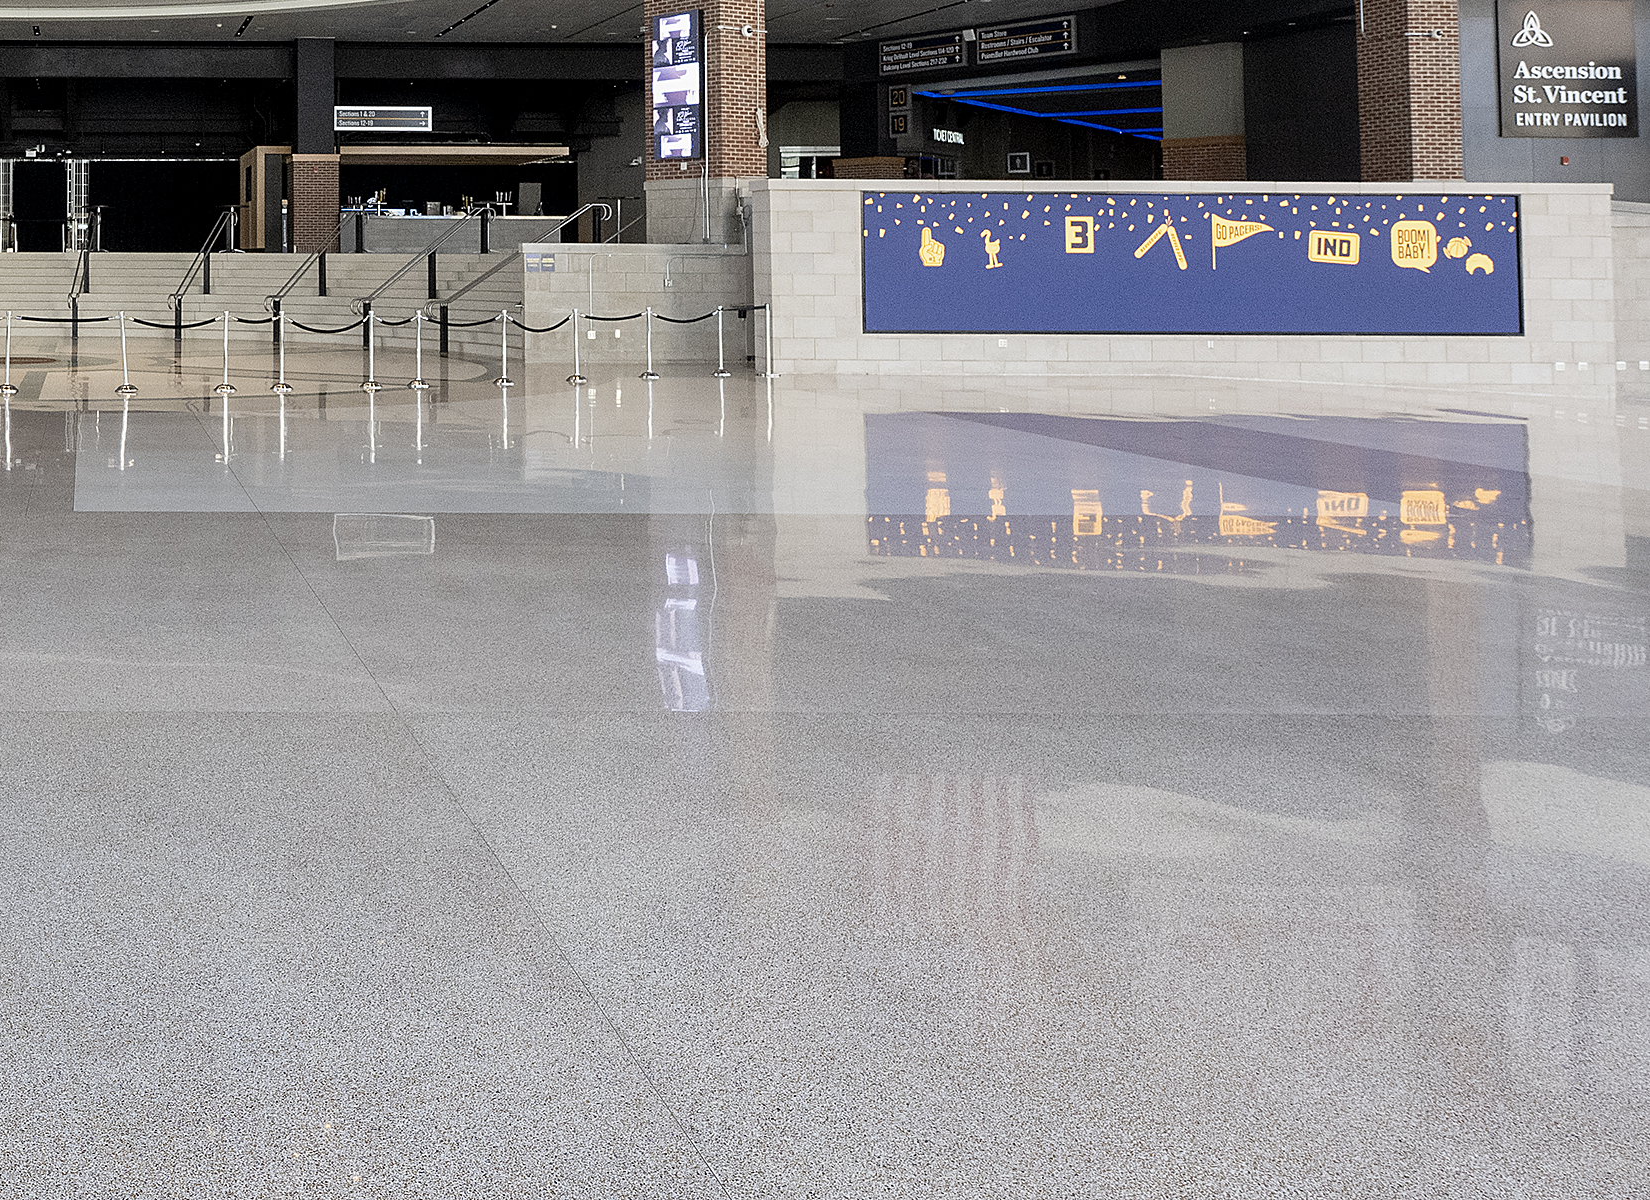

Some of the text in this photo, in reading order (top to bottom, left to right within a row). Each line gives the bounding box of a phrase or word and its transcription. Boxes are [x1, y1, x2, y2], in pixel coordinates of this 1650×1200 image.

[994, 30, 1007, 38] Store
[981, 41, 1007, 49] Restrooms
[1010, 38, 1025, 46] Stairs
[1029, 35, 1052, 43] Escalator
[920, 49, 937, 57] Sections
[1003, 48, 1027, 57] Hardwood
[1027, 46, 1039, 54] Club
[911, 60, 929, 68] Sections
[1513, 60, 1622, 80] Ascension
[892, 90, 905, 105] 20
[1513, 85, 1628, 104] St. Vincent
[894, 117, 905, 131] 19
[1516, 112, 1627, 127] ENTRY PAVILION
[1070, 220, 1089, 249] 3
[1216, 223, 1263, 240] GO PACERS!
[1317, 237, 1351, 258] IND
